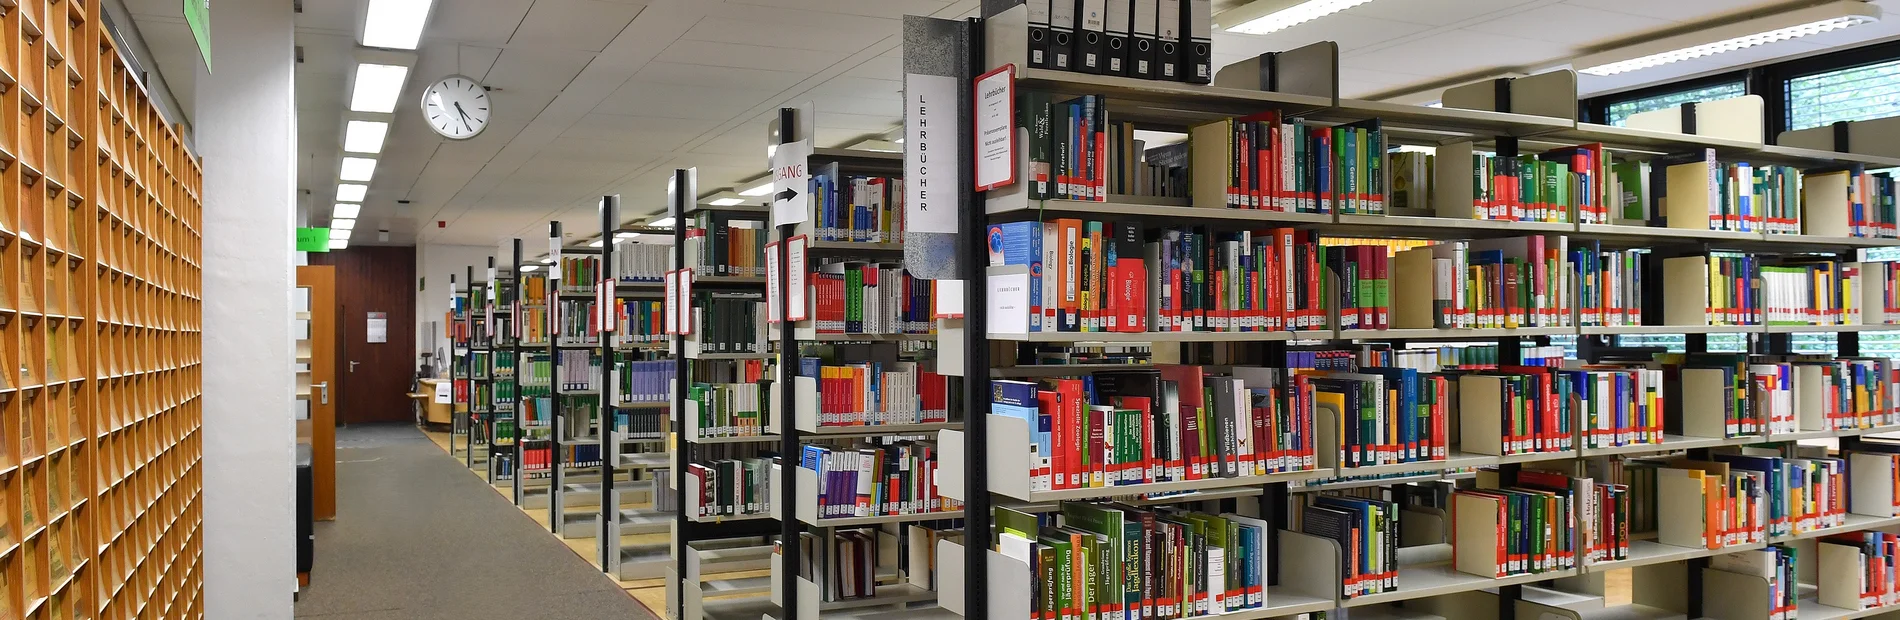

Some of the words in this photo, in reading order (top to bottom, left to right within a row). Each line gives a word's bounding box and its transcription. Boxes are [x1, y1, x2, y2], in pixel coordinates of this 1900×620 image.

[985, 87, 1006, 99] Lehrbücher
[1038, 117, 1045, 126] &
[919, 95, 928, 212] LEHRBÜCHER
[1067, 240, 1075, 265] Biologie
[1130, 539, 1140, 593] Jagdlexikon
